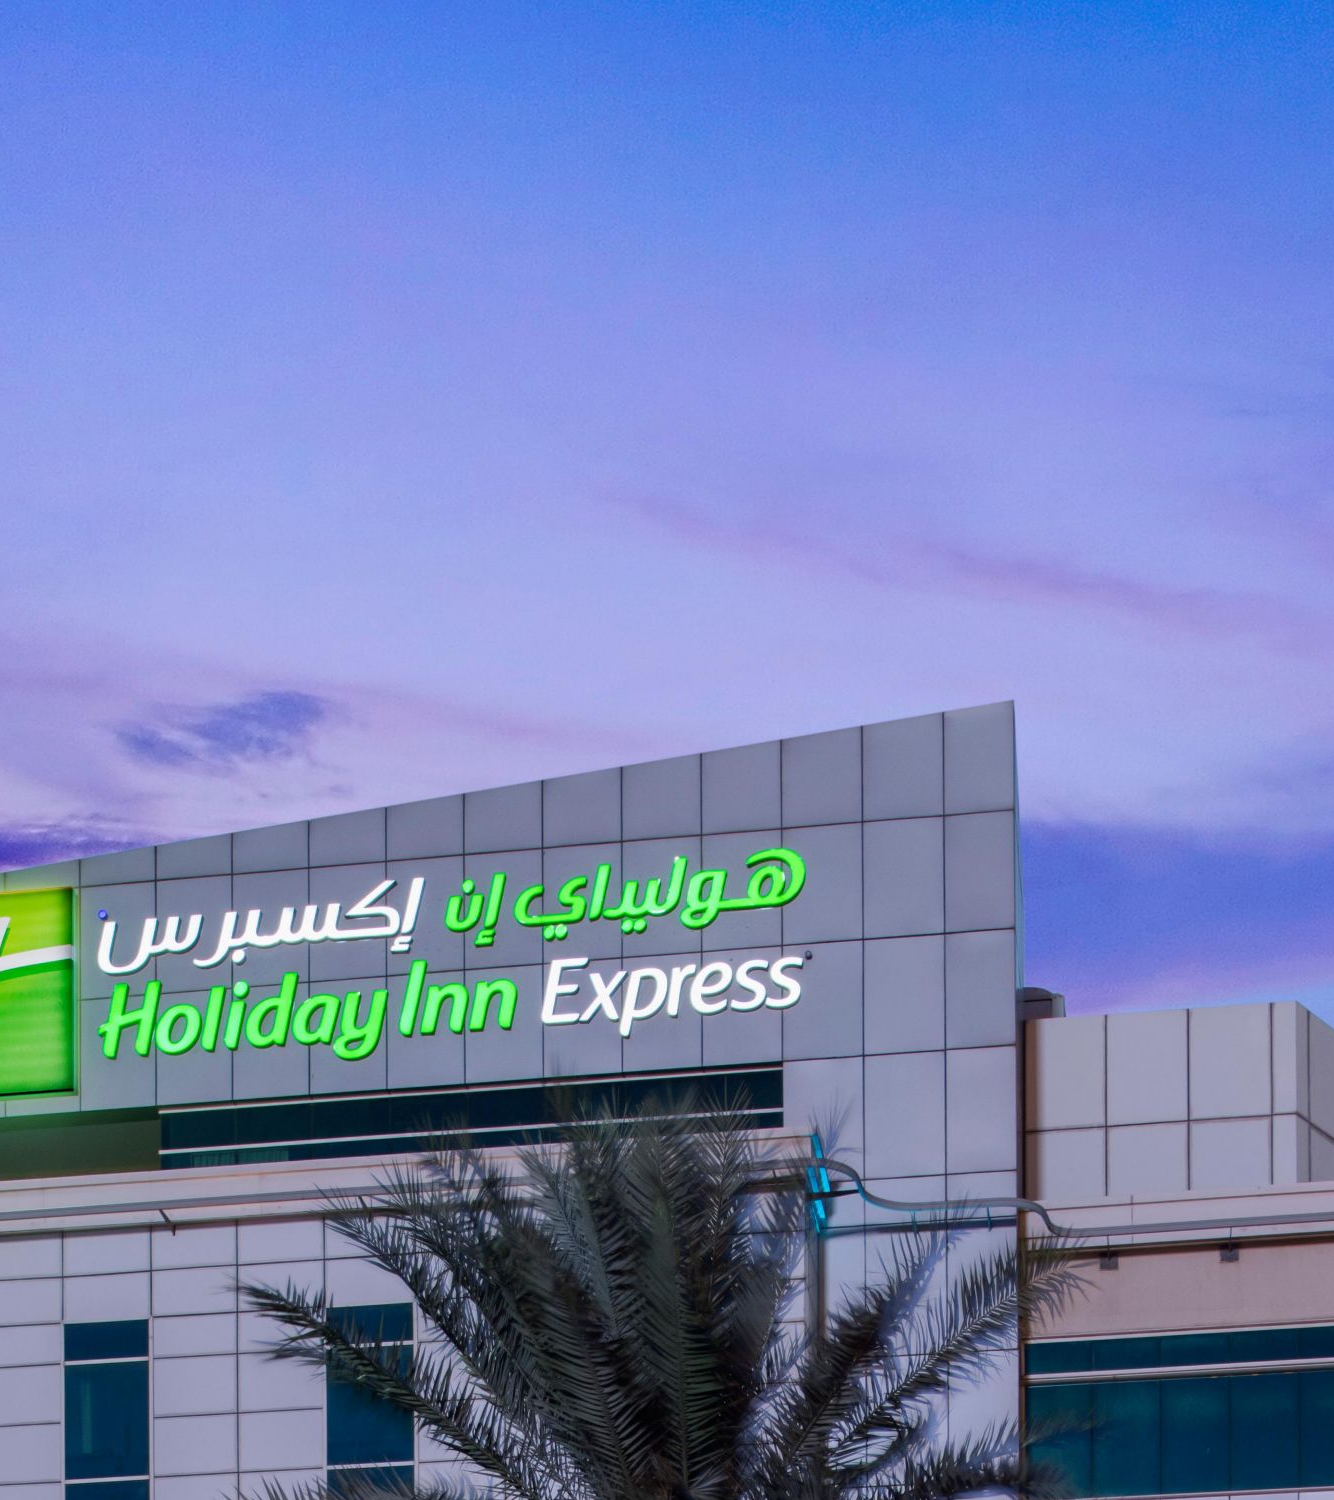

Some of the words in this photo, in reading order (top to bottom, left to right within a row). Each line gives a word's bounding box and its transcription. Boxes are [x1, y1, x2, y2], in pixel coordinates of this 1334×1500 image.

[97, 877, 425, 975] إكسبرس
[445, 872, 506, 946] إن
[514, 848, 806, 941] هوليداي
[98, 971, 388, 1060] Holiday
[398, 959, 518, 1037] Inn
[540, 956, 803, 1037] Express
